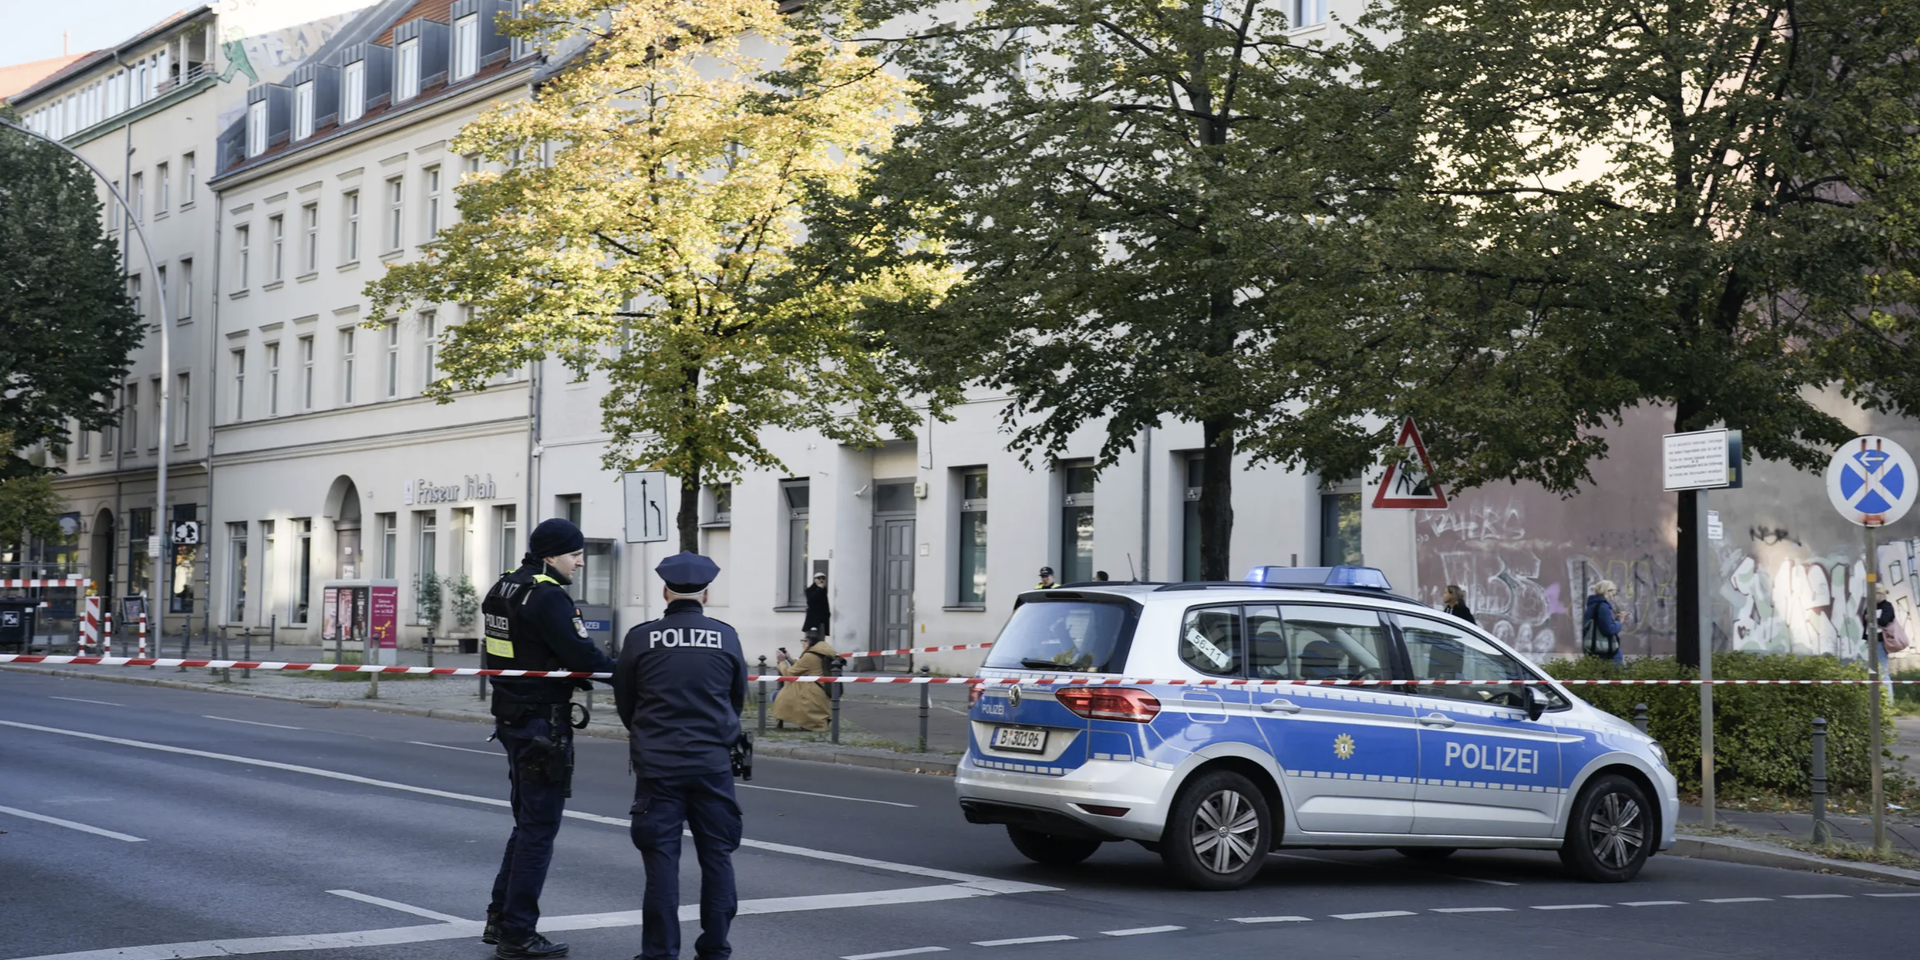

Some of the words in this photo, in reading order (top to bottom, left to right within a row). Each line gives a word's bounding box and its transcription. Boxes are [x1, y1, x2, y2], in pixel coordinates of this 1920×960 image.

[416, 478, 460, 503] Friseur
[486, 613, 509, 631] POLIZEI
[585, 621, 600, 630] IZEI
[649, 628, 722, 649] POLIZEI
[1193, 634, 1222, 661] 56-11
[981, 704, 1005, 715] POLIZEI
[1444, 741, 1539, 775] POLIZEI
